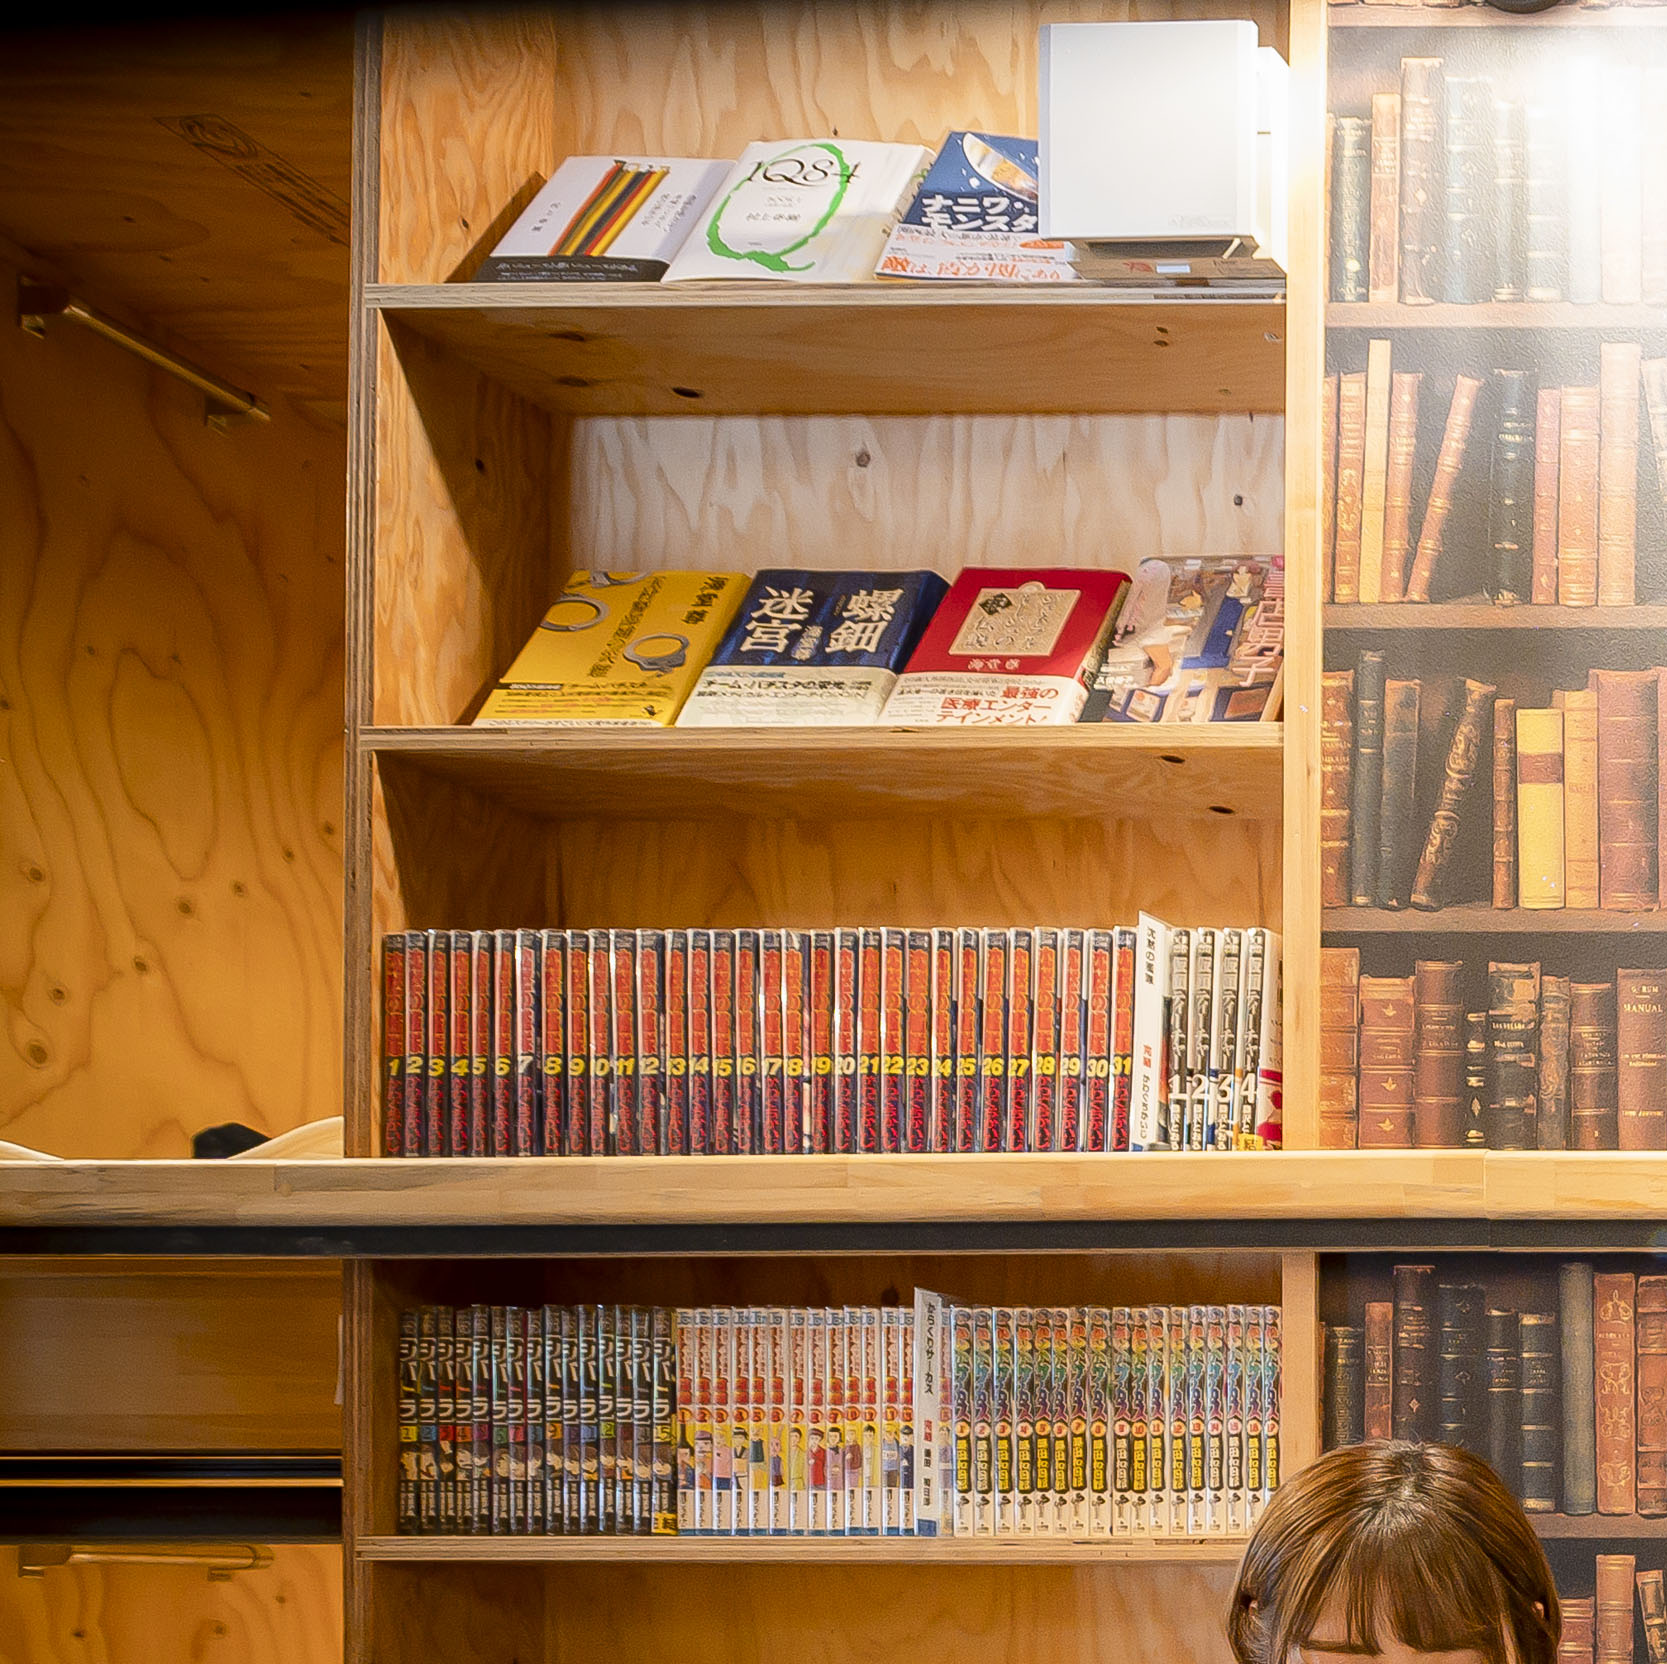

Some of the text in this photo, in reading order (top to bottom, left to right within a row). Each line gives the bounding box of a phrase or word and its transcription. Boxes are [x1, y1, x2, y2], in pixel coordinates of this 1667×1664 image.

[747, 158, 861, 188] 1Q84
[739, 586, 814, 653] 迷宮
[825, 588, 904, 654] 螺鈿
[1001, 686, 1059, 700] 最強の
[940, 698, 1052, 713] 医療エンター
[1623, 1003, 1664, 1014] MANUAL
[389, 1058, 399, 1075] 1
[450, 1057, 470, 1075] 4
[544, 1057, 562, 1075] 8
[616, 1057, 634, 1075] 11
[906, 1057, 930, 1075] 23
[1167, 1075, 1187, 1100] 1
[1190, 1075, 1209, 1100] 2
